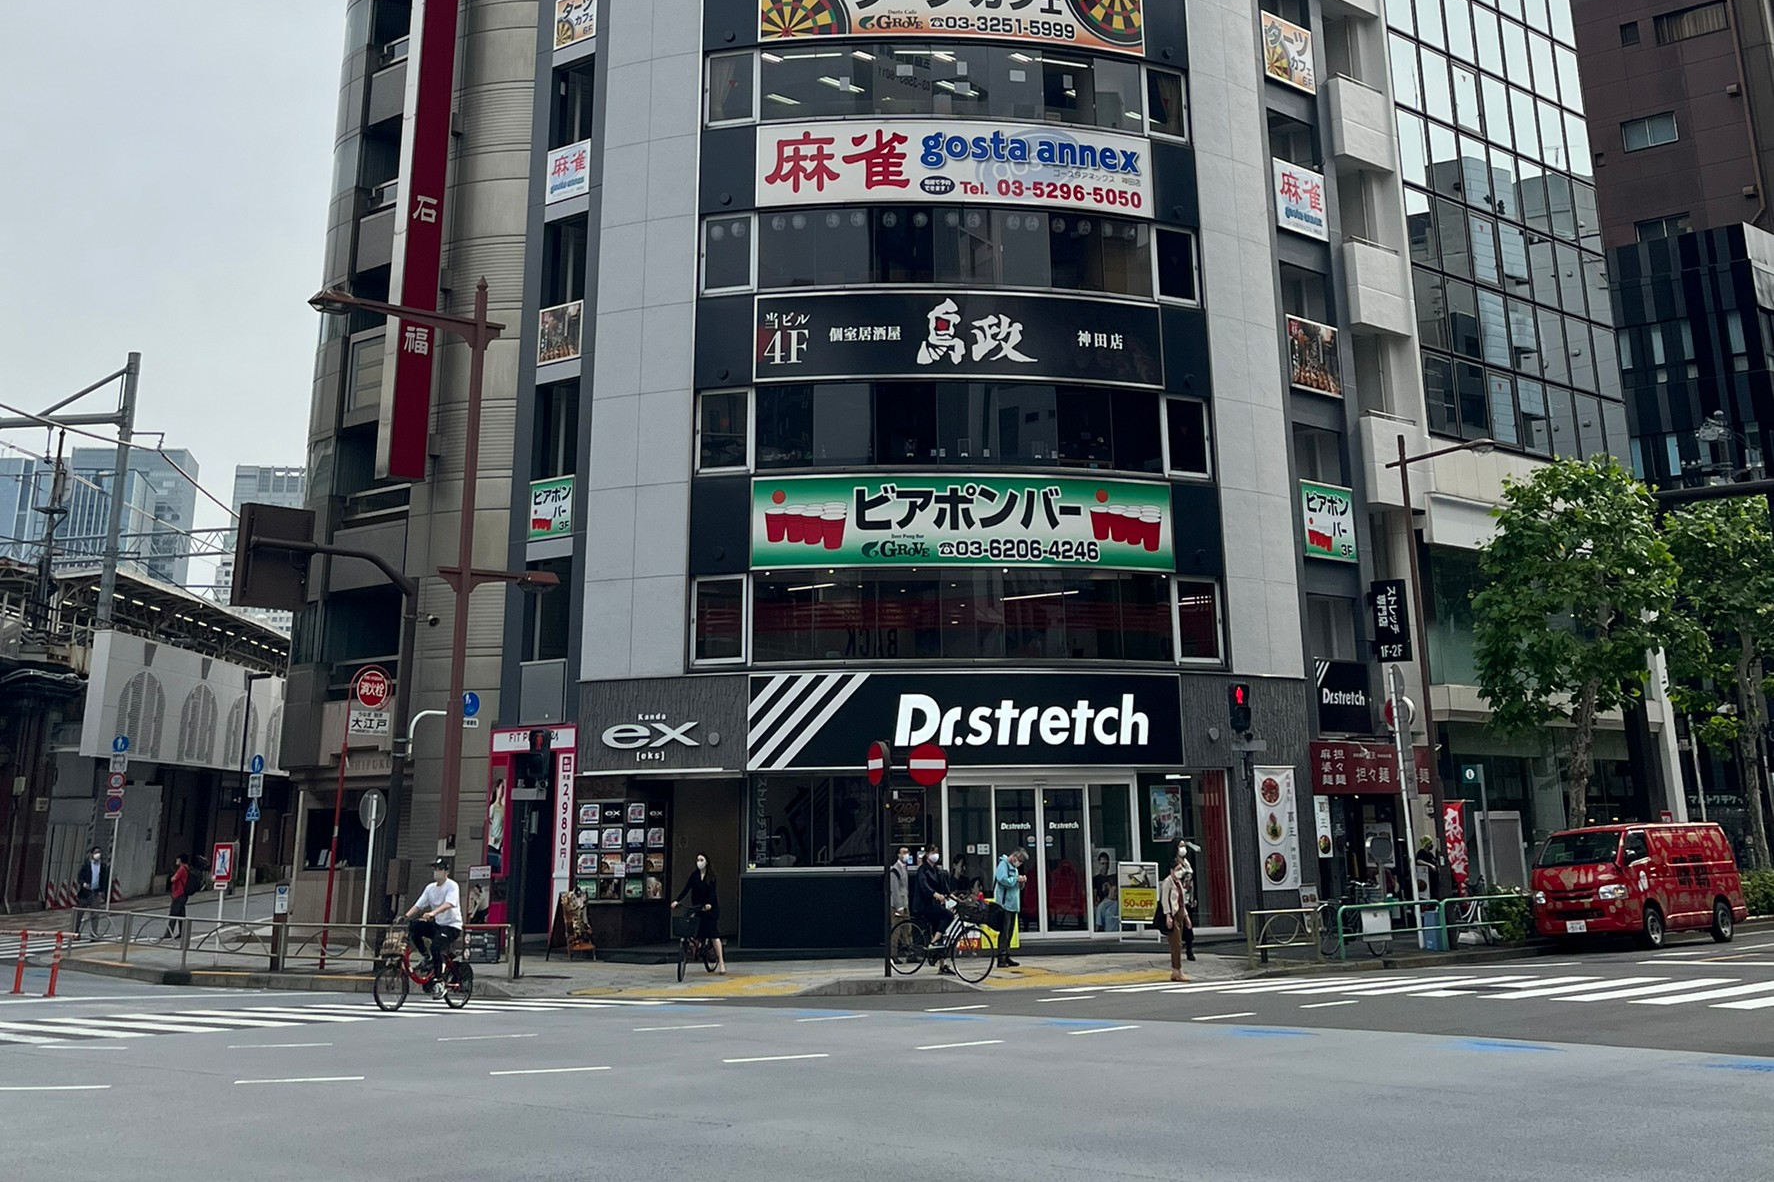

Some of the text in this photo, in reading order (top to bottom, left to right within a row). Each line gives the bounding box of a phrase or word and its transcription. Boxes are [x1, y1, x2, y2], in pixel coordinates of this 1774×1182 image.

[574, 13, 594, 26] カフェ
[583, 25, 593, 34] 6F
[945, 17, 1075, 40] 03-3251-5999
[1267, 21, 1308, 57] ダーツ
[1291, 56, 1312, 78] カフェ
[1302, 76, 1313, 87] 6F
[764, 129, 911, 194] 麻雀
[920, 130, 1141, 175] gosta annex
[552, 150, 586, 177] 麻雀
[959, 179, 1142, 209] Tel. 03-5296-5050
[1280, 171, 1323, 213] 麻雀
[764, 312, 810, 330] 当ビル
[829, 326, 901, 342] 個室居酒屋
[1077, 330, 1123, 349] 神田店
[763, 329, 809, 364] 4F
[534, 487, 571, 506] ビアポン
[855, 484, 1082, 530] ビアポンバー
[1306, 492, 1348, 516] ビアポン
[559, 521, 569, 530] 3F
[956, 540, 1099, 561] 03-6206-4246
[1341, 544, 1353, 556] 3F
[1376, 594, 1388, 627] 専門店
[1387, 586, 1400, 634] ストレッチ
[360, 682, 384, 697] 消火栓
[1322, 687, 1365, 706] Dr.stretch
[351, 718, 387, 729] 大江戸
[894, 693, 1149, 747] Dr.stretch
[601, 721, 700, 749] ex
[1356, 766, 1390, 784] 担々麺
[1000, 822, 1031, 830] Dr.stretch
[1049, 821, 1079, 830] Dr.stretch
